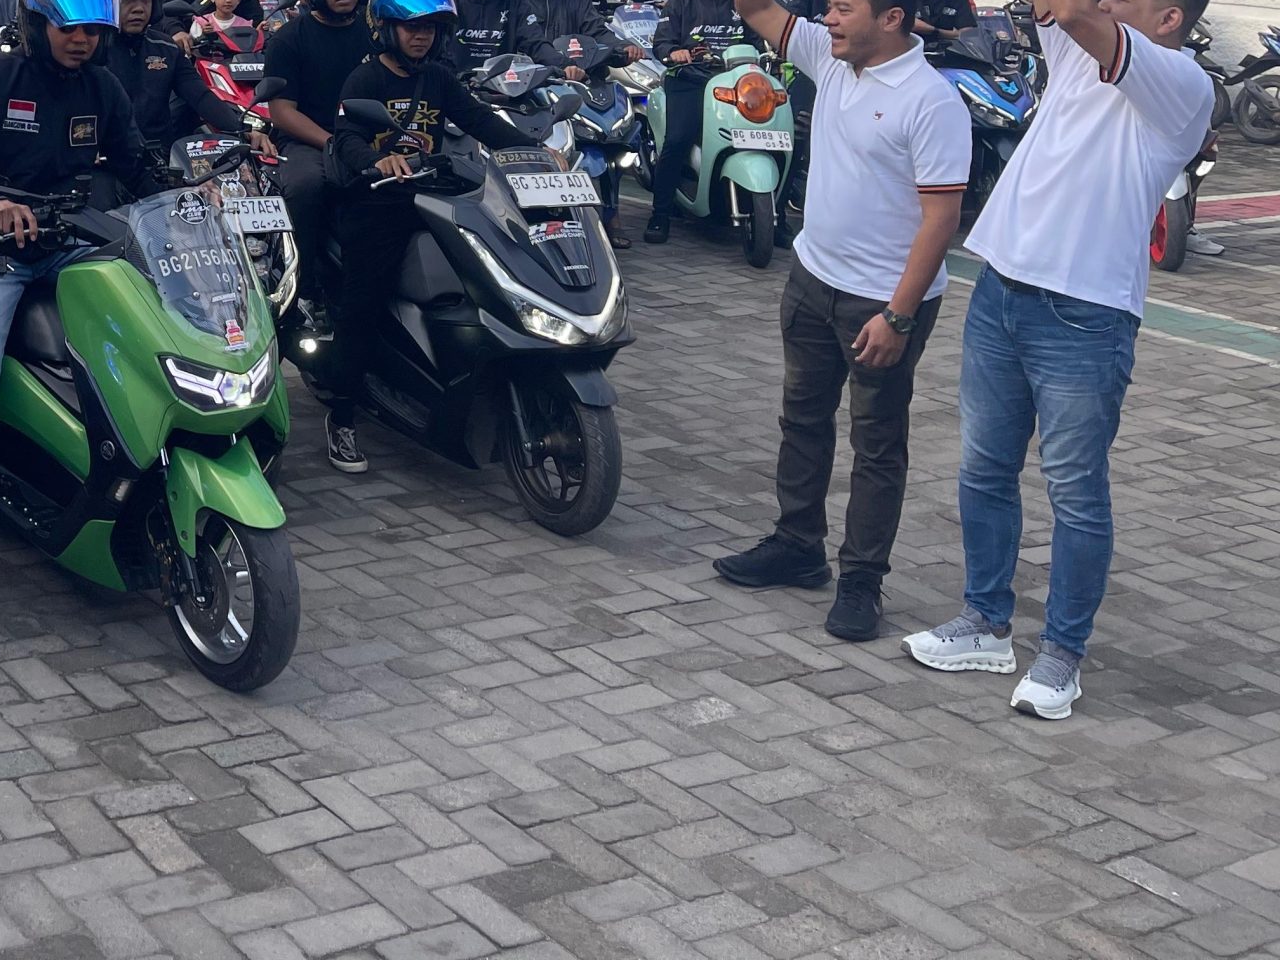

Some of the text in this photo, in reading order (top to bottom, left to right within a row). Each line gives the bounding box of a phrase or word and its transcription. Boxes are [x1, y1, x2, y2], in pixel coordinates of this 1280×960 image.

[465, 29, 489, 39] ONE
[704, 25, 725, 33] ONE
[511, 176, 529, 189] BG
[531, 175, 563, 189] 3345
